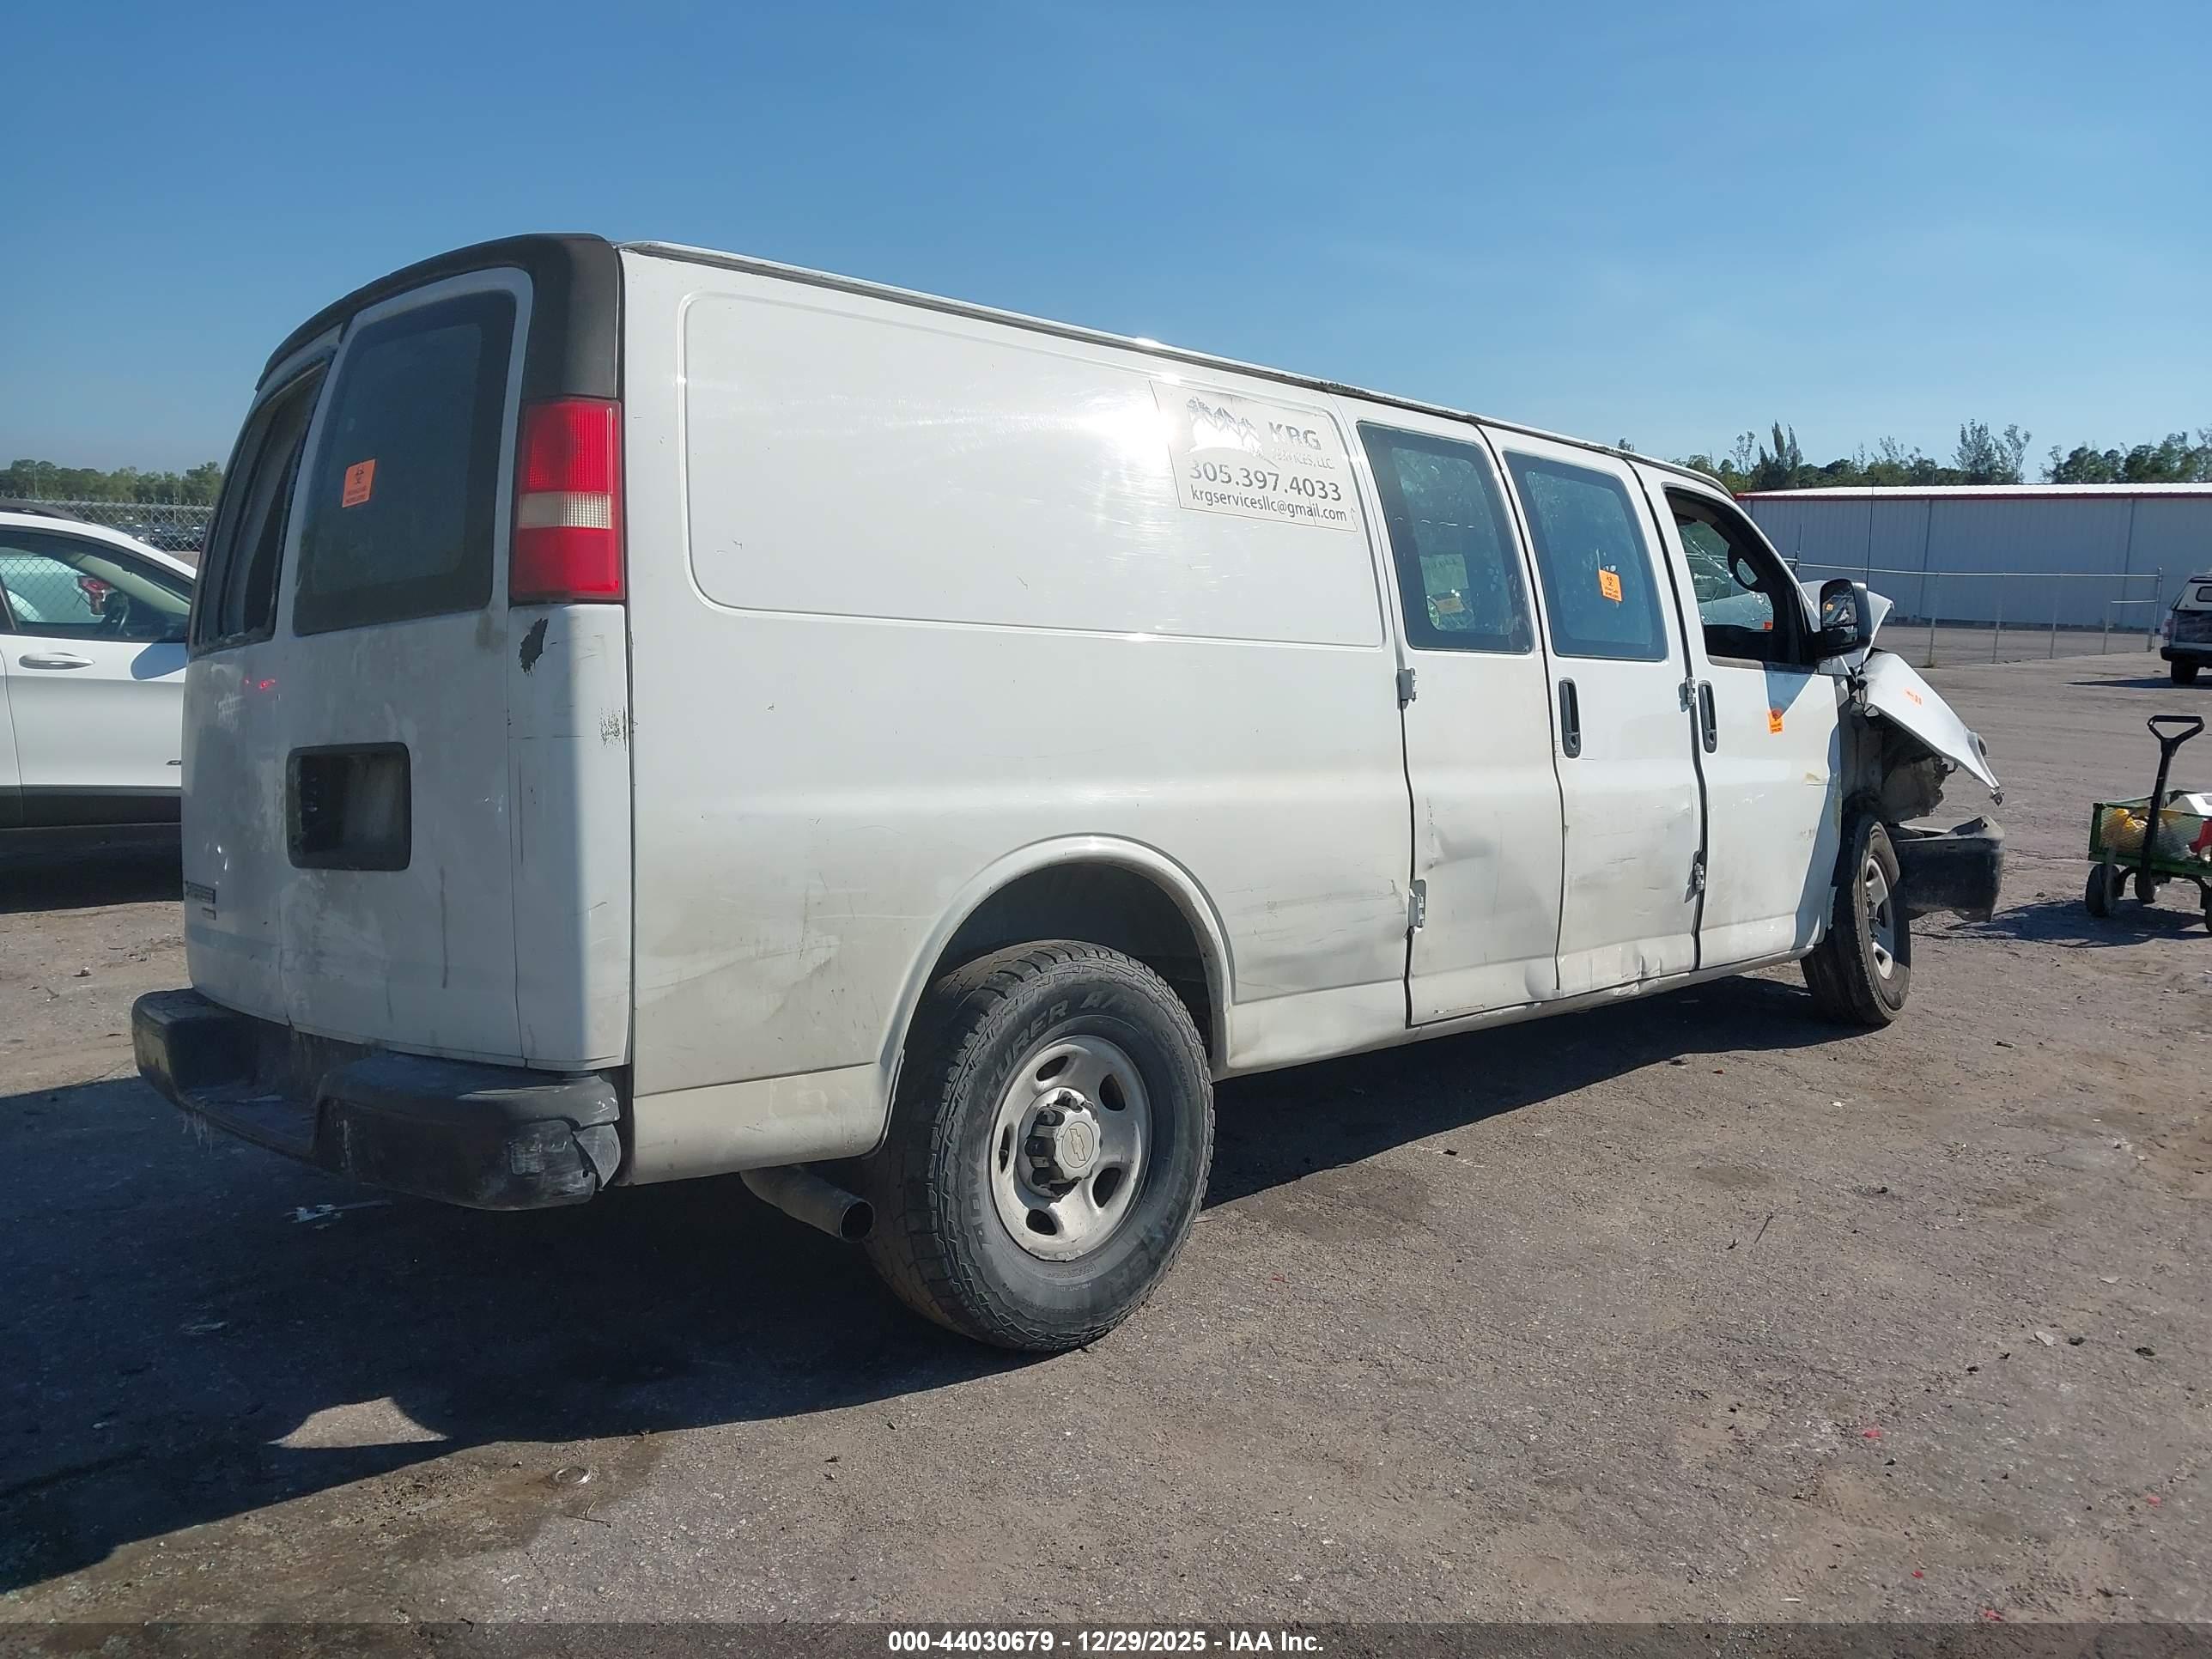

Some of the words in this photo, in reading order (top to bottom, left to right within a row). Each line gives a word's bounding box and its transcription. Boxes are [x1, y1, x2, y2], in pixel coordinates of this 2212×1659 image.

[1268, 421, 1322, 451] KRG
[1189, 460, 1342, 502] 305.397.4033
[1190, 484, 1347, 522] krgservicesllc@gmail.com
